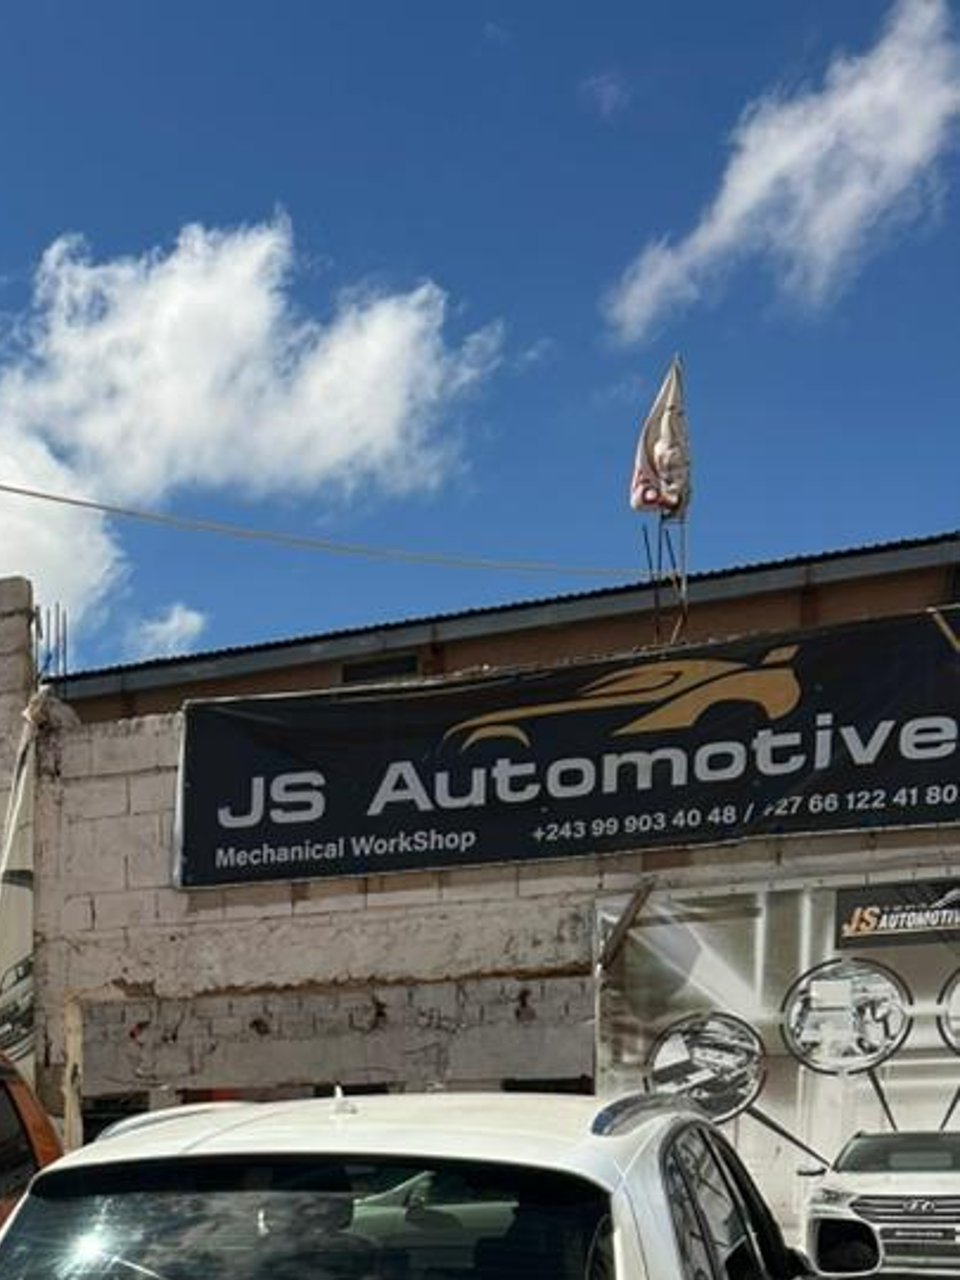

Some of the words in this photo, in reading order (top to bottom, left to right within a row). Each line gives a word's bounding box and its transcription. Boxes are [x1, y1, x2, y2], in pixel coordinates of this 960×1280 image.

[217, 770, 326, 829] JS
[366, 713, 958, 817] Automotive
[533, 821, 587, 841] +243
[591, 817, 619, 837] 99
[624, 812, 666, 834] 903
[672, 808, 702, 828] 40
[707, 805, 737, 824] 48
[808, 793, 839, 813] 66
[844, 789, 886, 810] 122
[892, 787, 918, 807] 41
[925, 784, 958, 805] 80
[215, 838, 345, 868] Mechanical
[350, 829, 477, 857] WorkShop
[841, 906, 881, 935] JS
